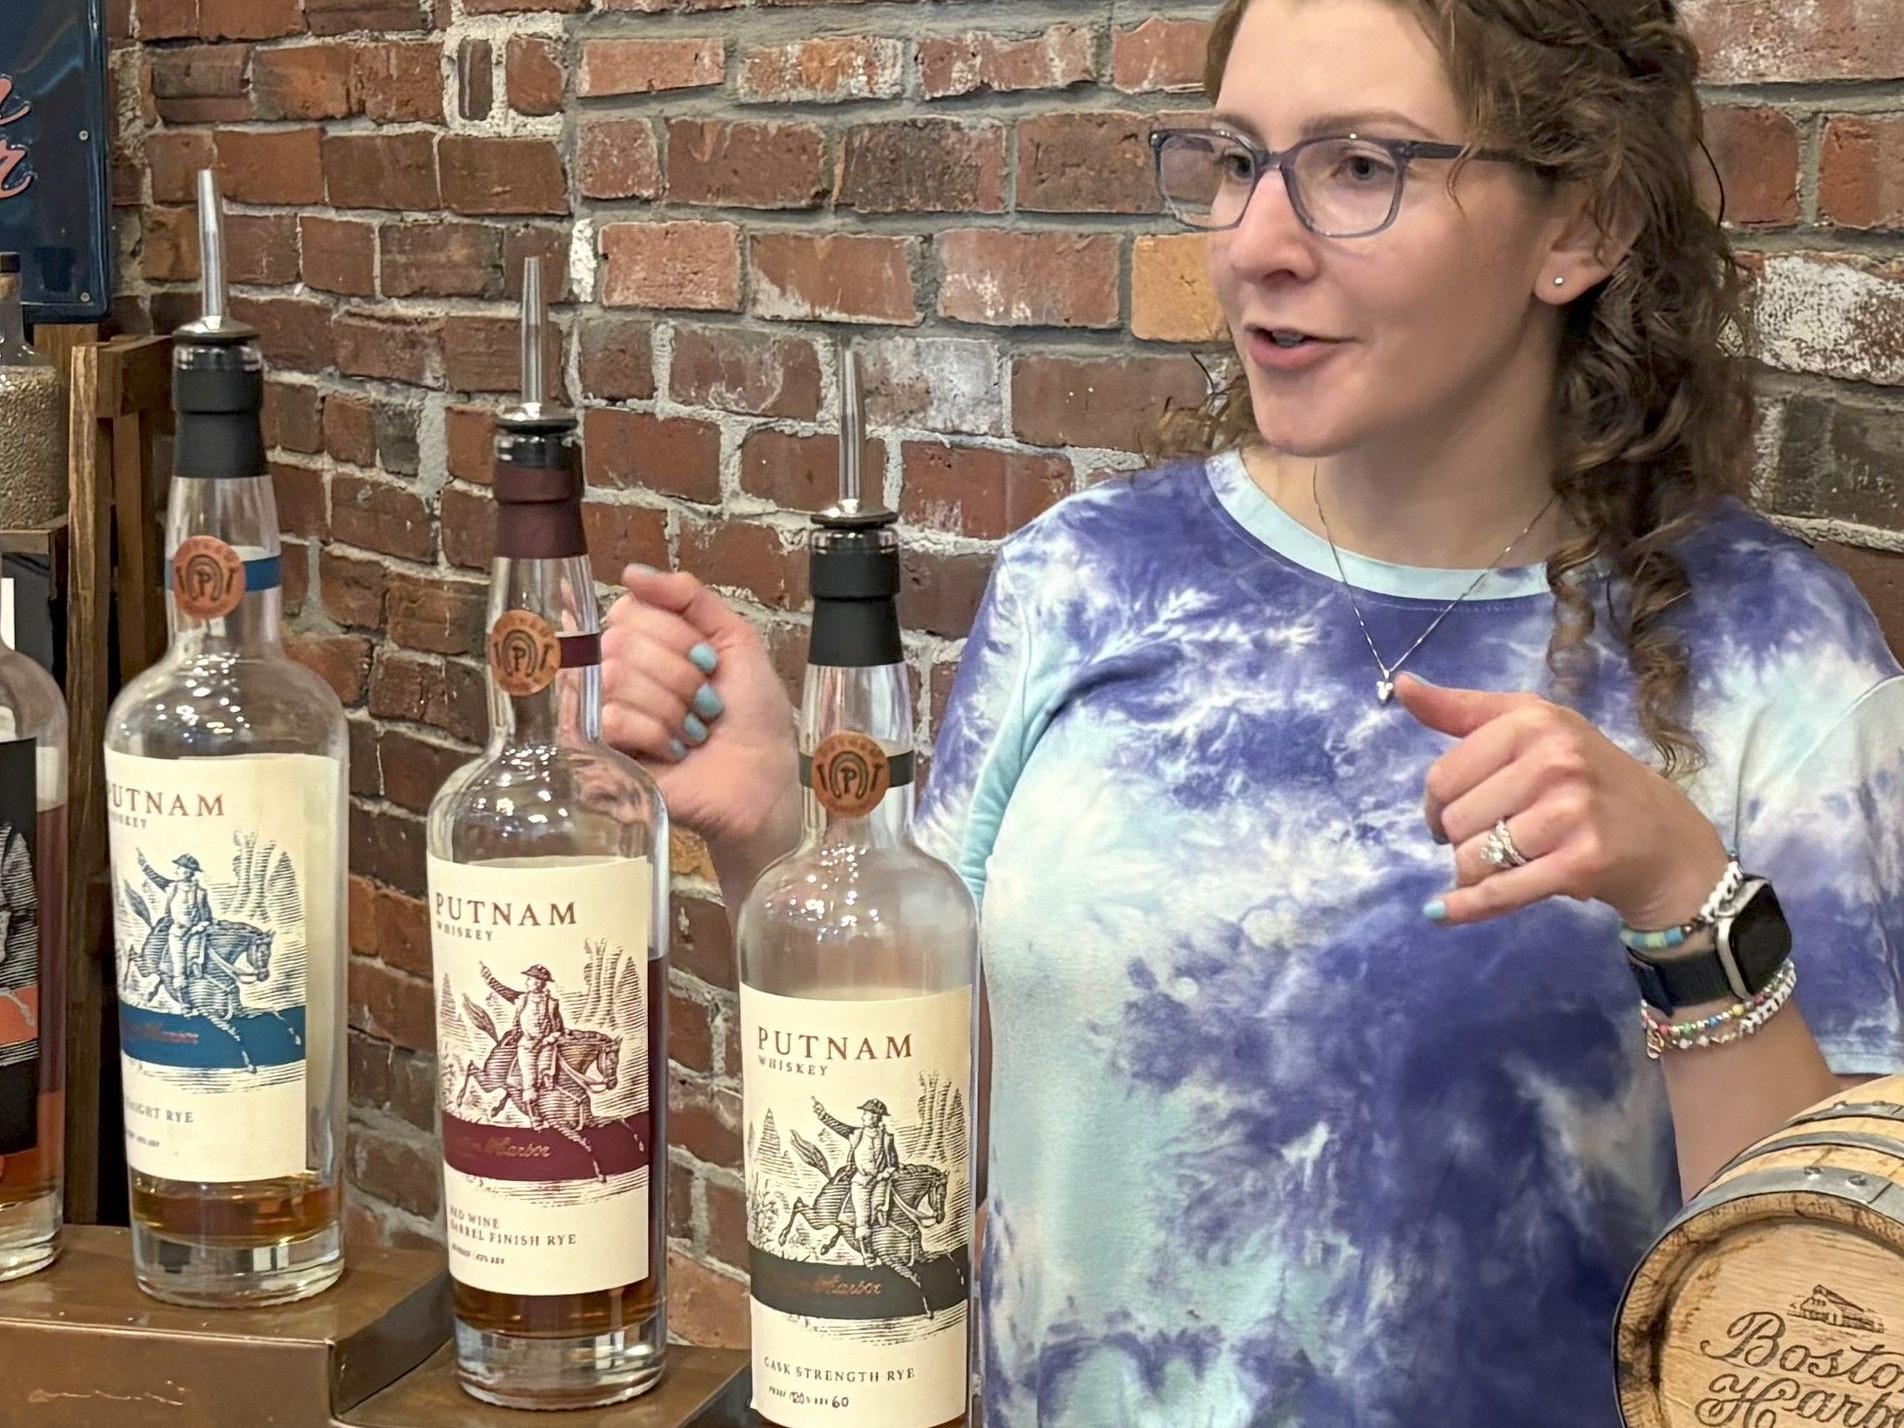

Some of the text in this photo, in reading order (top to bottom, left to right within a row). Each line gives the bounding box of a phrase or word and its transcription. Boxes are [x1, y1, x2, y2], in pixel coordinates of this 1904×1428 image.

[108, 782, 225, 817] UTNAM
[435, 891, 577, 927] PUTNAM
[435, 919, 493, 942] WHISKEY
[757, 1025, 913, 1061] PUTNAM
[757, 1054, 828, 1077] WHISKEY
[165, 1109, 195, 1124] RYE
[467, 1211, 500, 1231] WINE
[489, 1232, 541, 1248] FINISH
[546, 1233, 578, 1247] RYE
[763, 1356, 916, 1383] CASK STRENGTH RYE
[831, 1395, 850, 1409] 60
